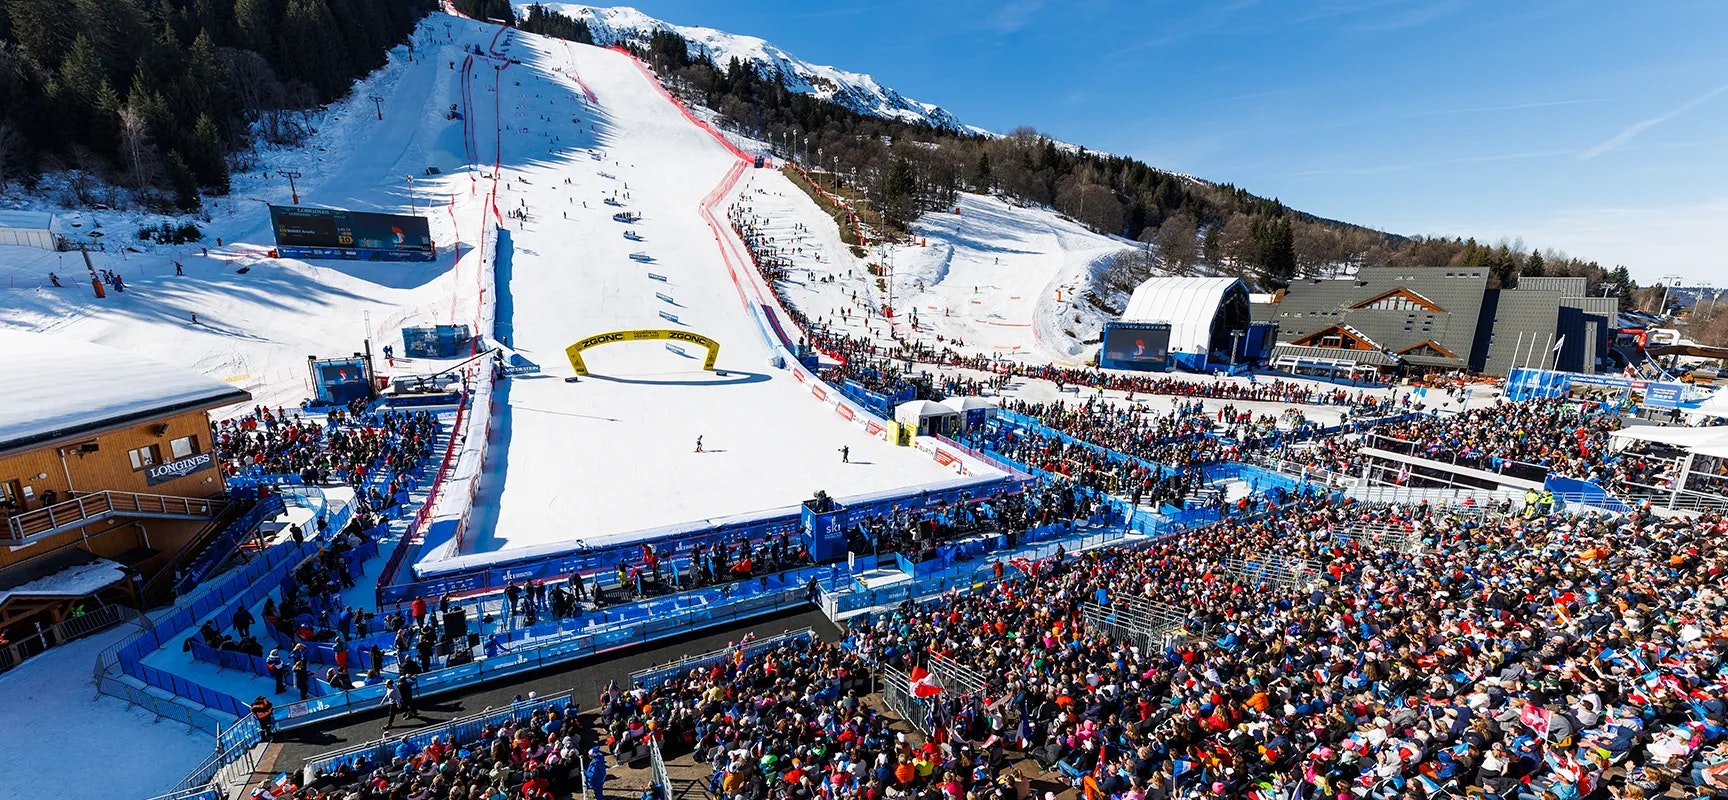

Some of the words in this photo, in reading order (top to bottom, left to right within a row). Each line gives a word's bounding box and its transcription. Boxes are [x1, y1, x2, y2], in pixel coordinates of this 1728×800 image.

[582, 333, 623, 348] ZGONC
[669, 331, 707, 345] ZGONC
[150, 453, 210, 477] LONGINES
